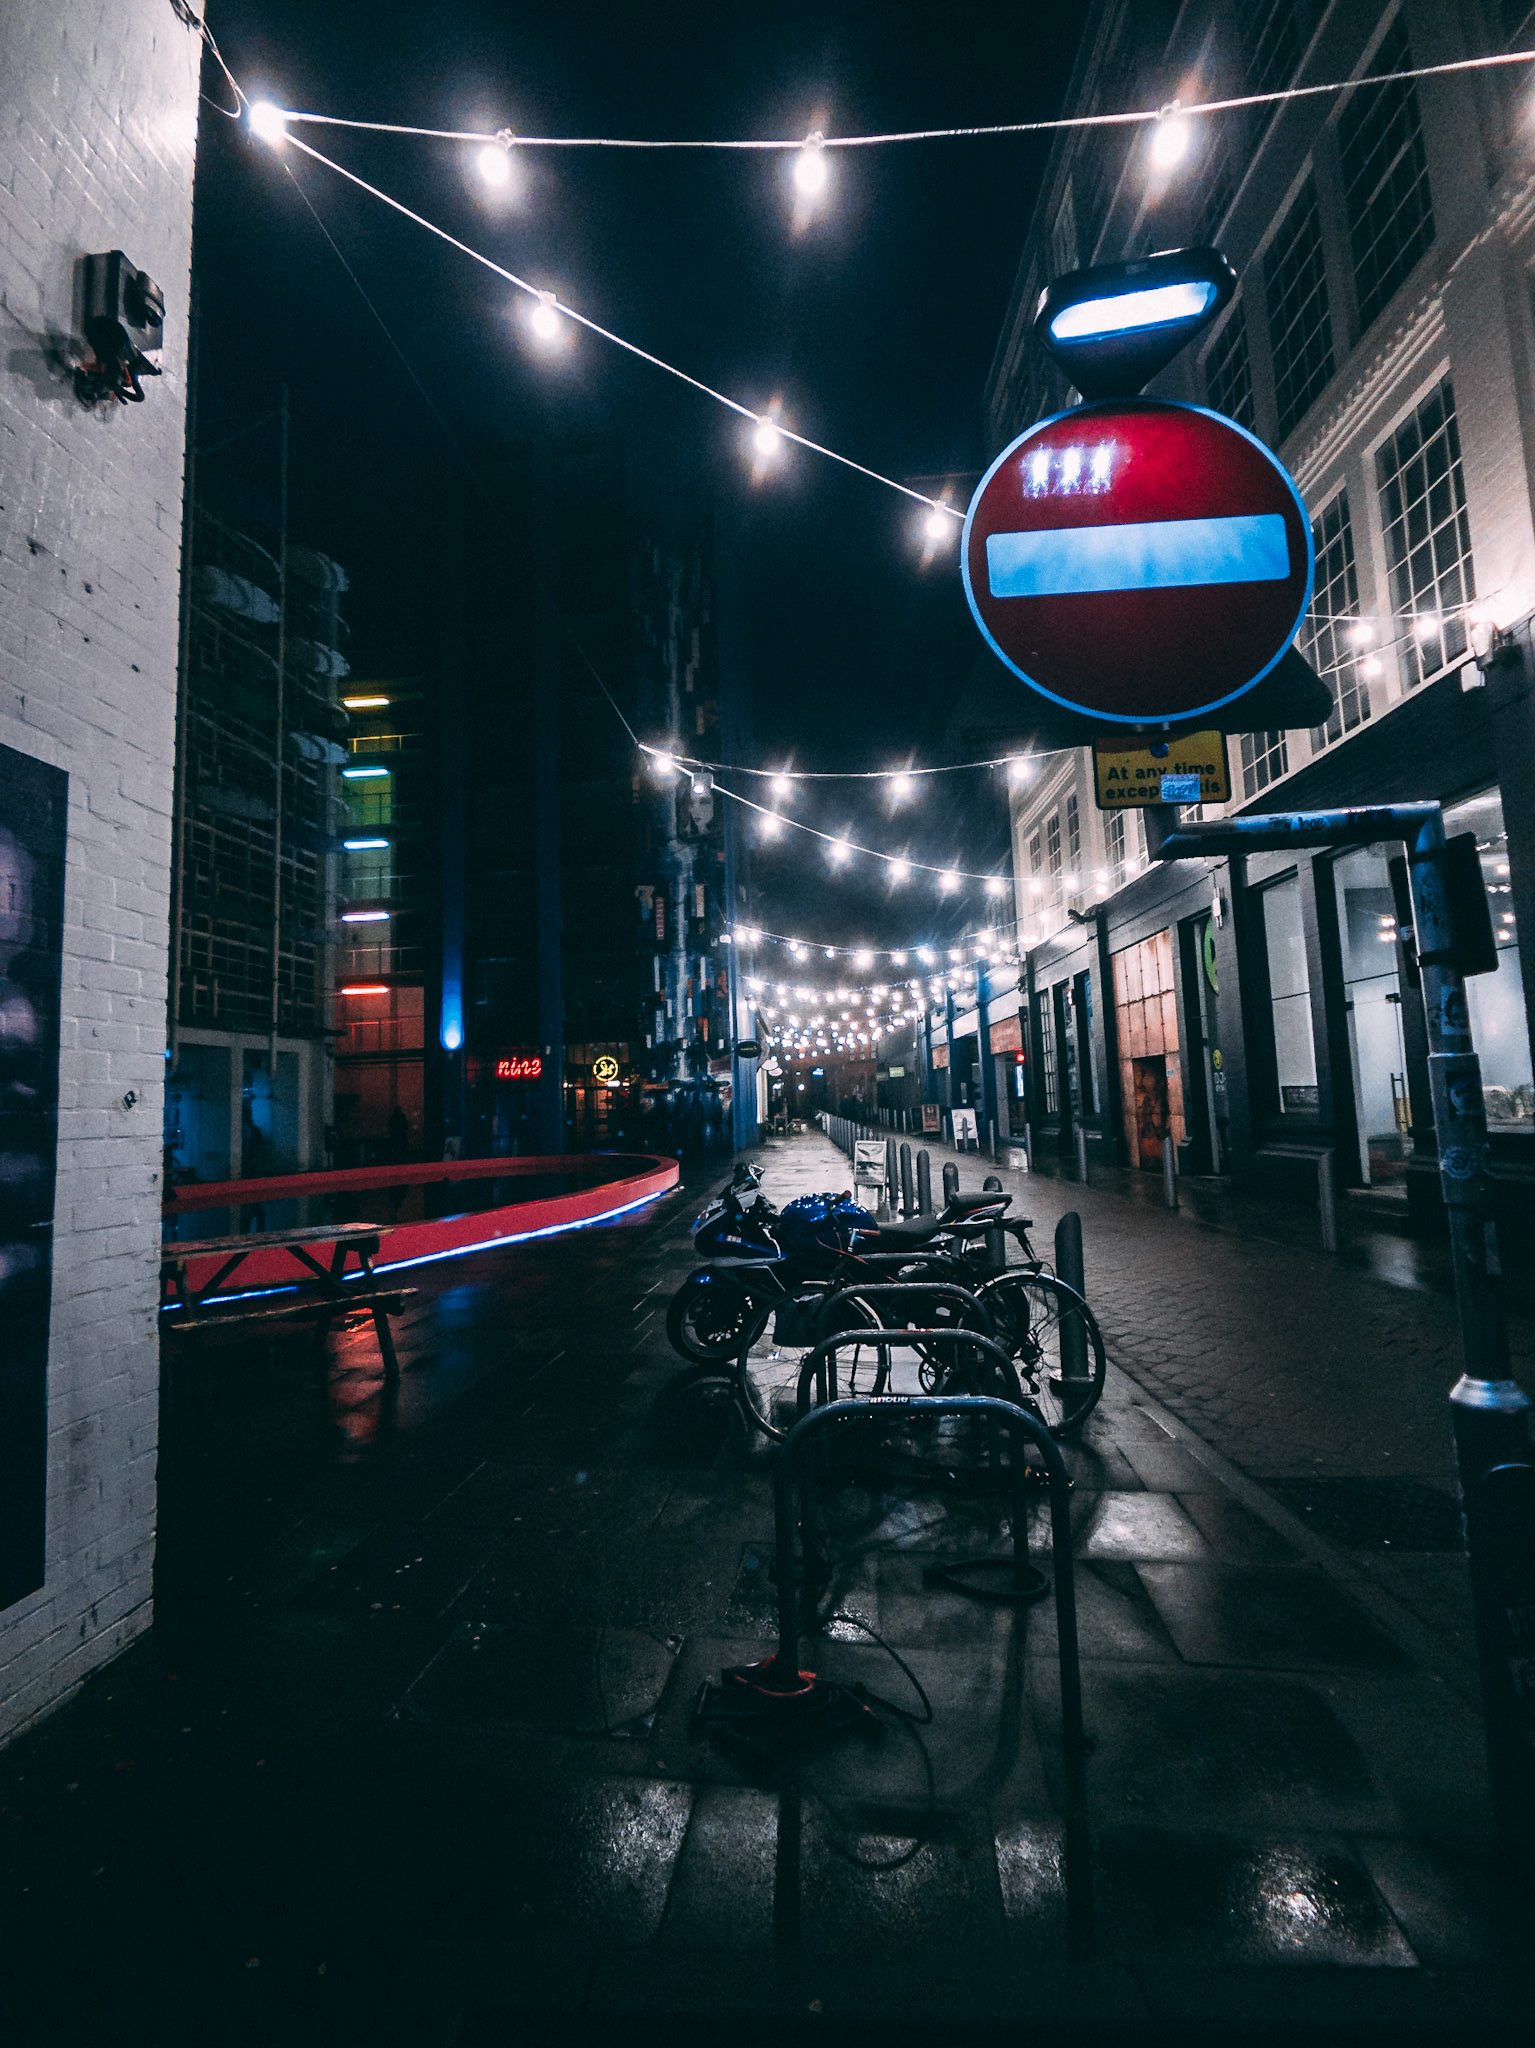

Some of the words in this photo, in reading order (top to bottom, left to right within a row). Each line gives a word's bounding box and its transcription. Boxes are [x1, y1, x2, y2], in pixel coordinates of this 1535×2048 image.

[1108, 766, 1128, 780] At
[1135, 766, 1167, 778] any
[1173, 762, 1216, 775] time
[1106, 785, 1159, 799] excep
